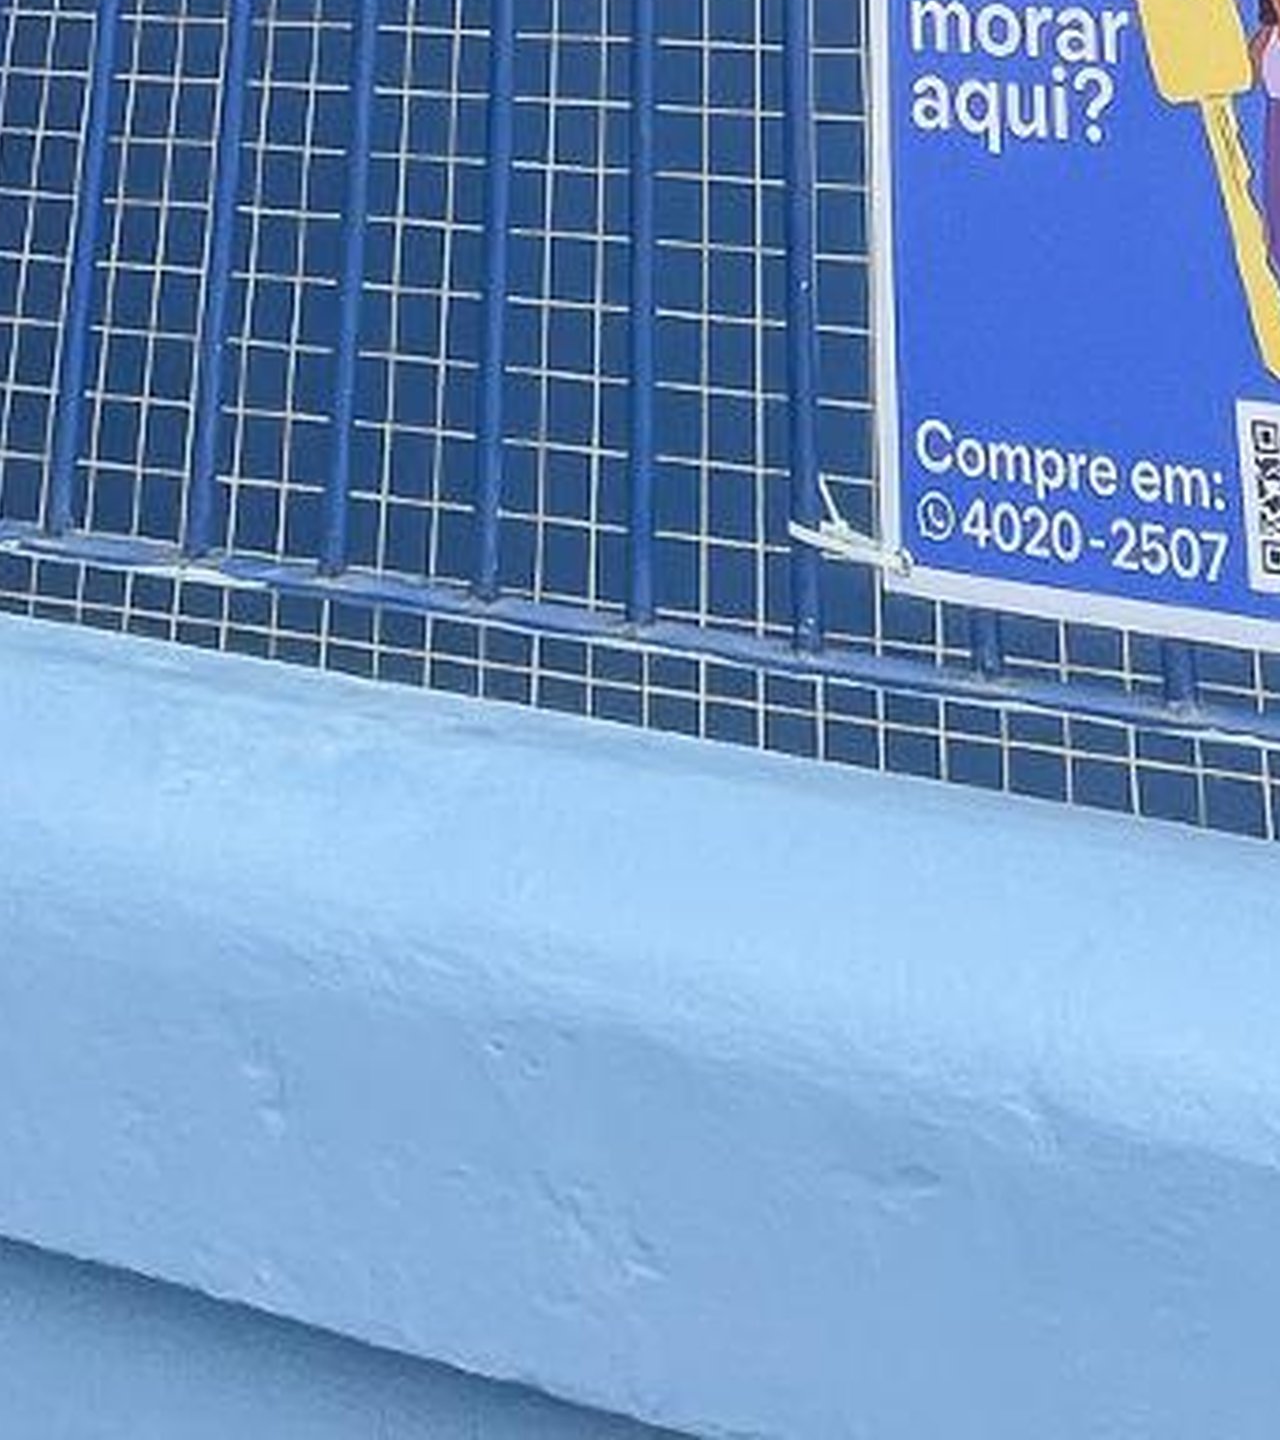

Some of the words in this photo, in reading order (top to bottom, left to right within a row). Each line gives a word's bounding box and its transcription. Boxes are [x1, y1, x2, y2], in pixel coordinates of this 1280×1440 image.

[910, 0, 1129, 64] morar
[912, 67, 1113, 154] aqui?
[917, 419, 1118, 498] Compre
[1130, 461, 1225, 511] em:
[962, 498, 1229, 582] 4020-2507
